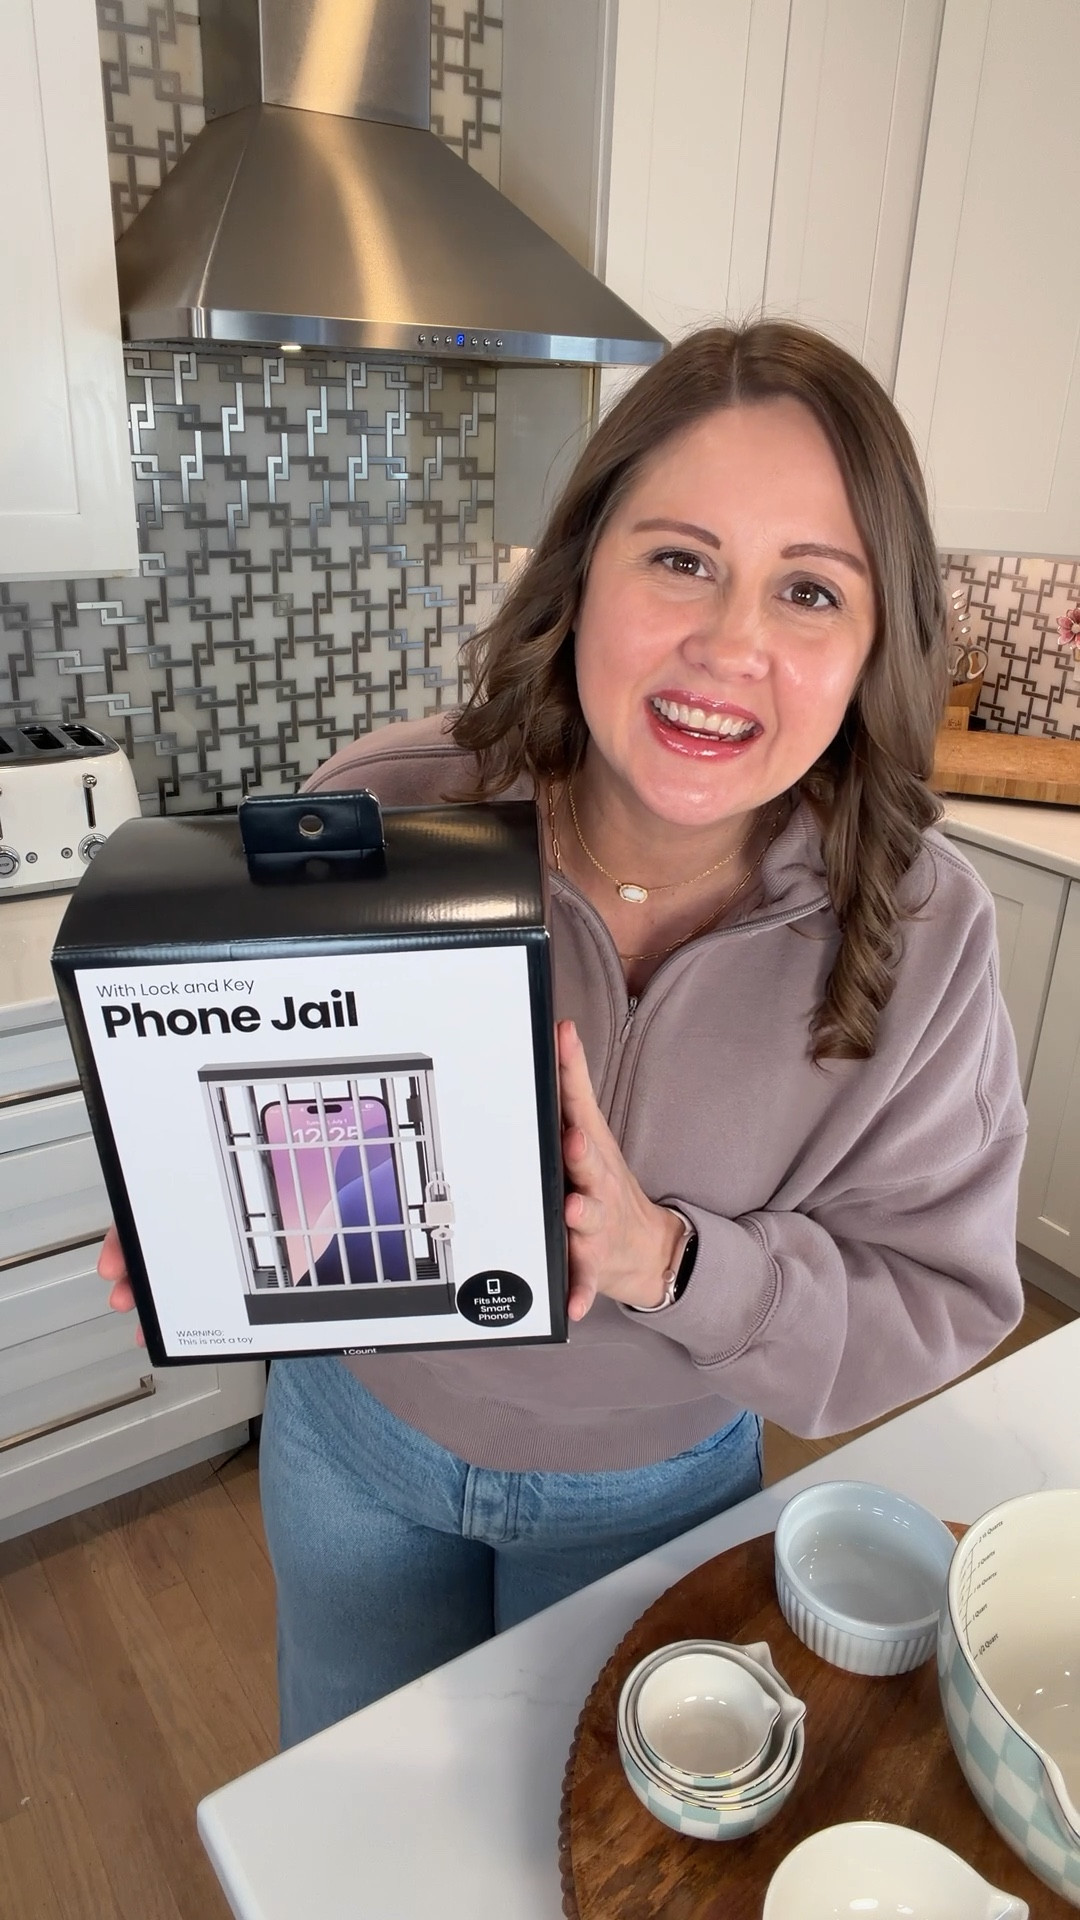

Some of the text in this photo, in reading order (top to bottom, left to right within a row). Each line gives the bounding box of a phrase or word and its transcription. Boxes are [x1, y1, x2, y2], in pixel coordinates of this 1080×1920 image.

[96, 978, 255, 998] With Lock and Key
[101, 989, 359, 1038] Phone Jail
[293, 1126, 359, 1142] 1225
[474, 1295, 516, 1305] Fits Most
[480, 1304, 511, 1313] Smart
[176, 1329, 224, 1337] WARNING:
[348, 1347, 377, 1355] Count
[985, 1633, 999, 1648] Quart
